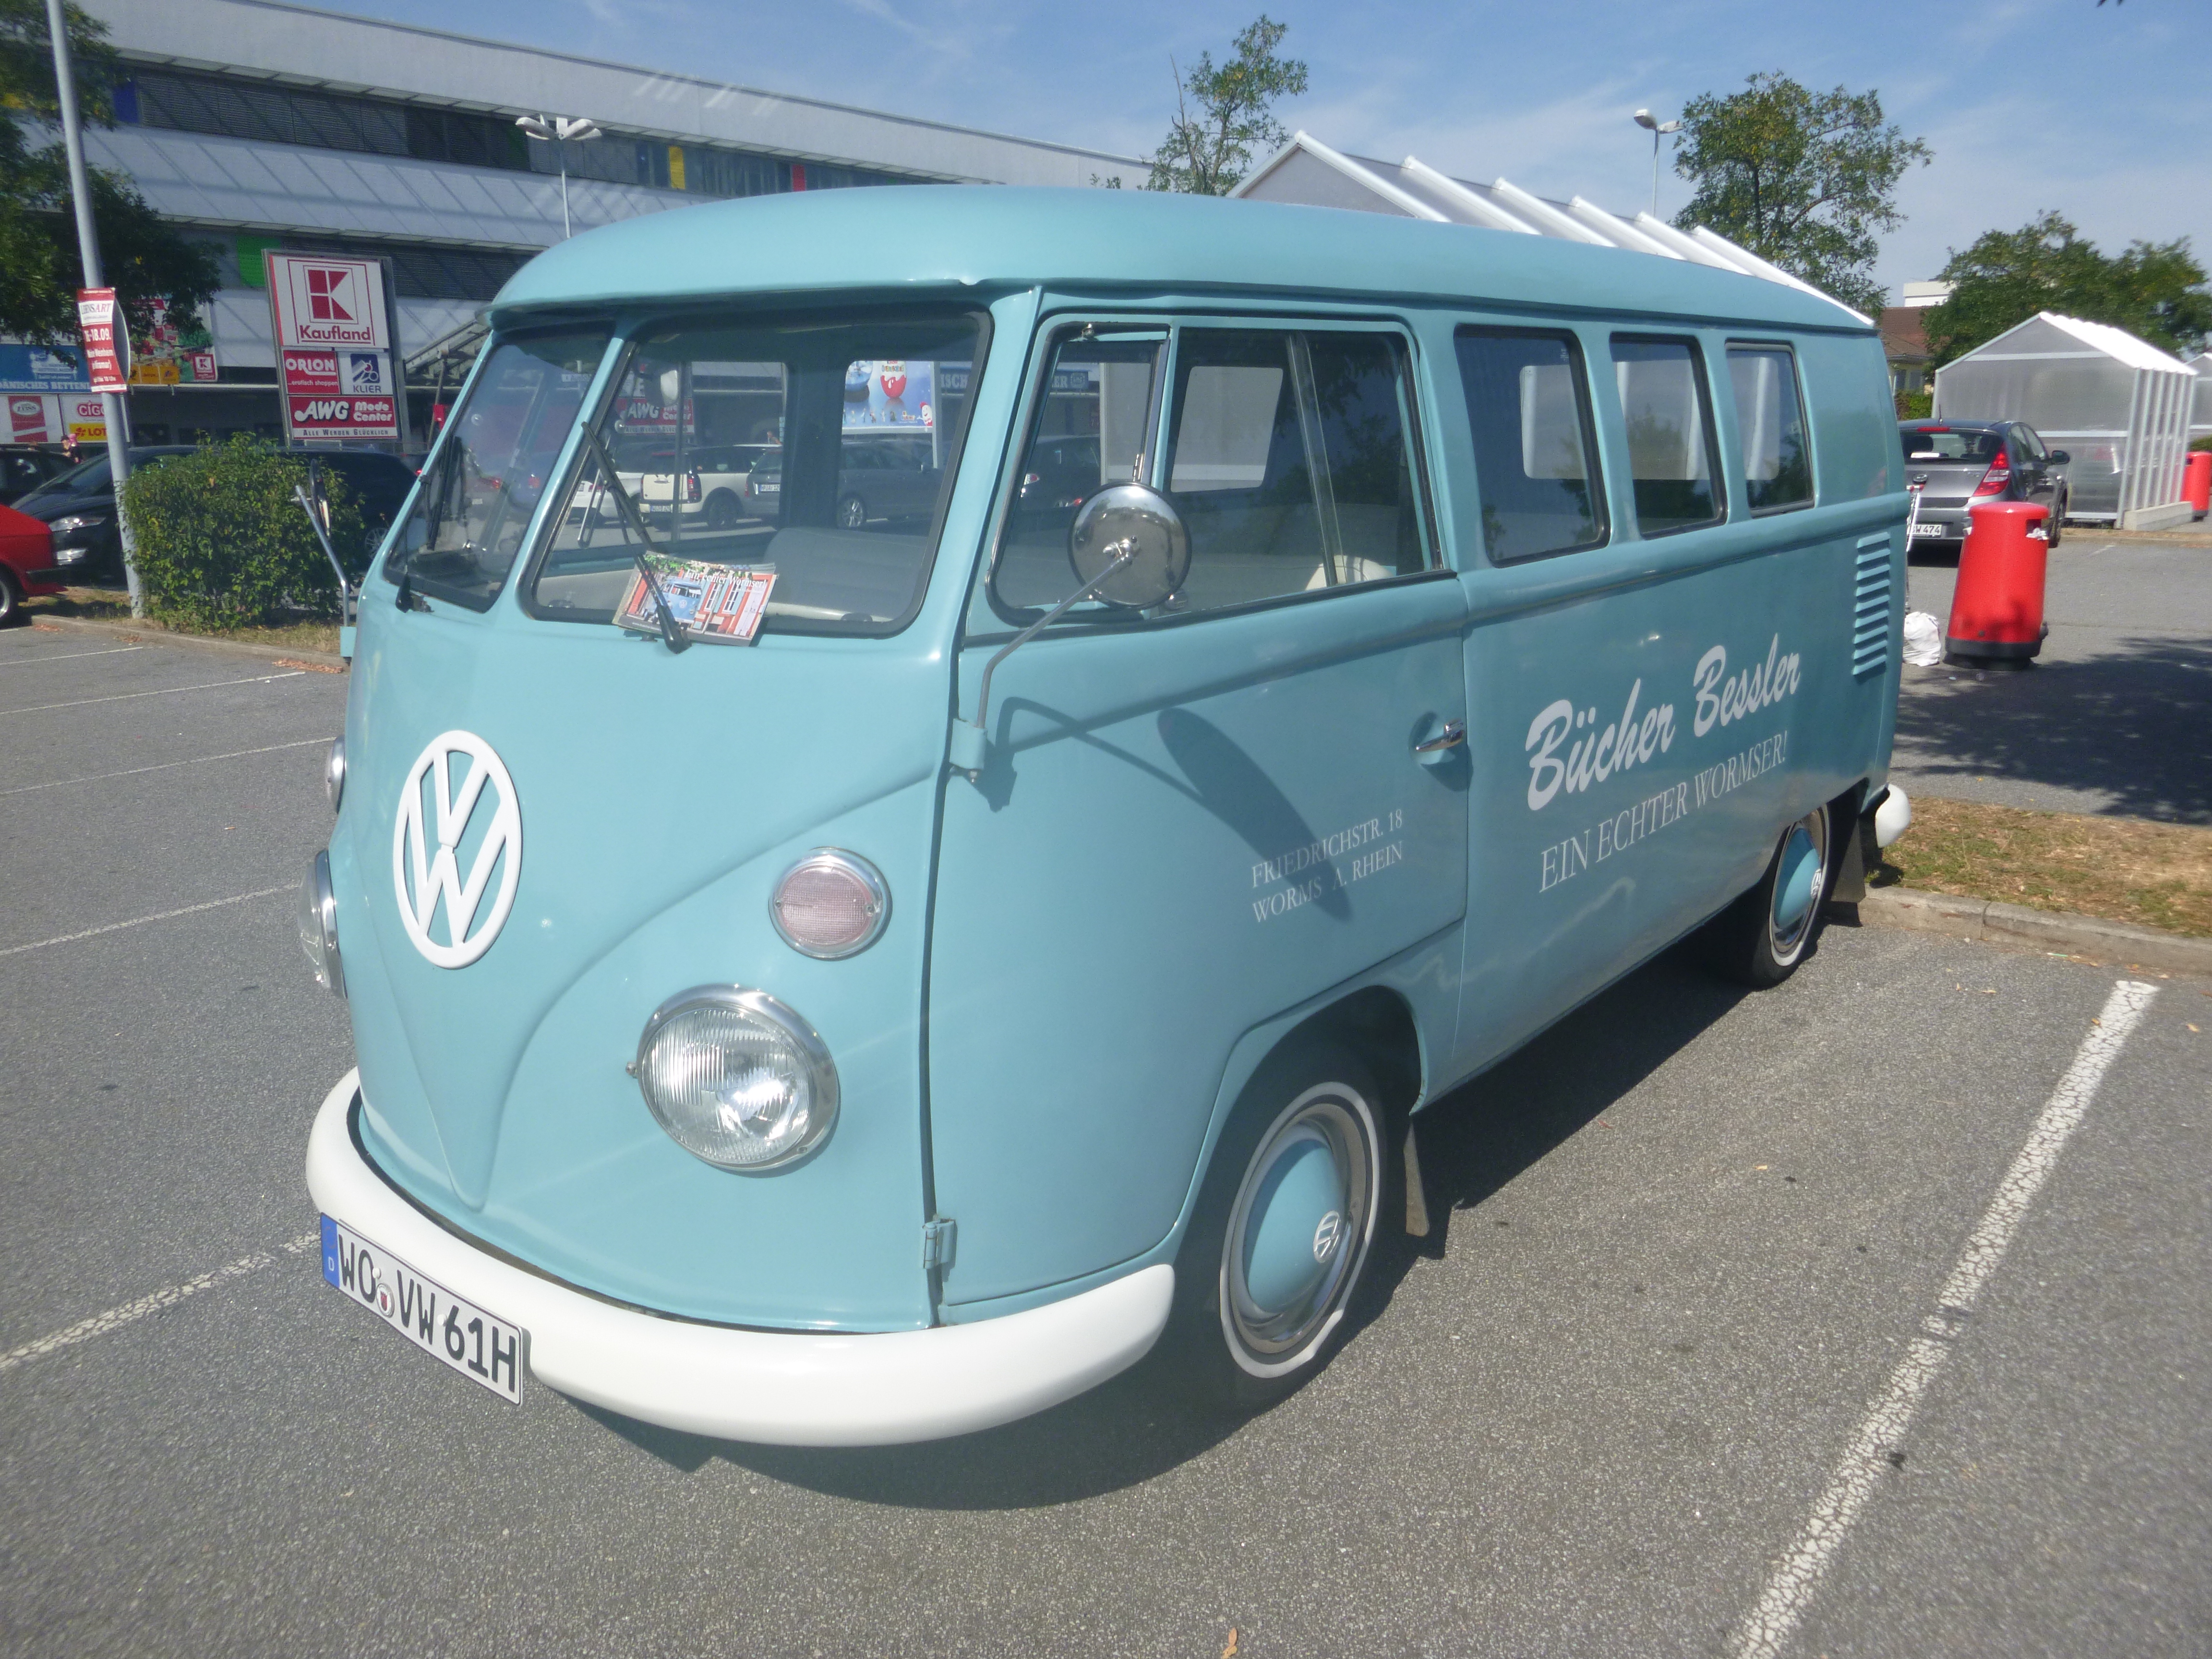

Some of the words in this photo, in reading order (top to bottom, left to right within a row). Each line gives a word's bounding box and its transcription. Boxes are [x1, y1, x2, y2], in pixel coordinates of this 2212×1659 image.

[299, 325, 371, 340] Kaufland
[286, 359, 336, 375] ORION
[353, 385, 382, 393] KLIER
[294, 400, 349, 422] AWG
[355, 401, 389, 411] Mode
[353, 412, 393, 422] Center
[88, 428, 107, 436] LOT
[1923, 525, 1940, 534] 474
[686, 569, 699, 581] Ein
[702, 573, 727, 585] echter
[729, 576, 767, 588] Wormser!
[1525, 678, 1676, 811] Bücher
[1693, 632, 1801, 737] Bessler
[1539, 829, 1590, 893] EIN
[1595, 781, 1688, 863] ECHTER
[1694, 730, 1788, 809] WORMSER!
[1251, 818, 1383, 888] FRIEDRICHSTR.
[1388, 808, 1402, 832] 18
[1252, 877, 1322, 923] WORMS
[1333, 867, 1347, 890] A.
[1352, 841, 1404, 882] RHEIN
[338, 1234, 376, 1303] WO
[397, 1269, 436, 1345] VW
[444, 1304, 516, 1393] 61H
